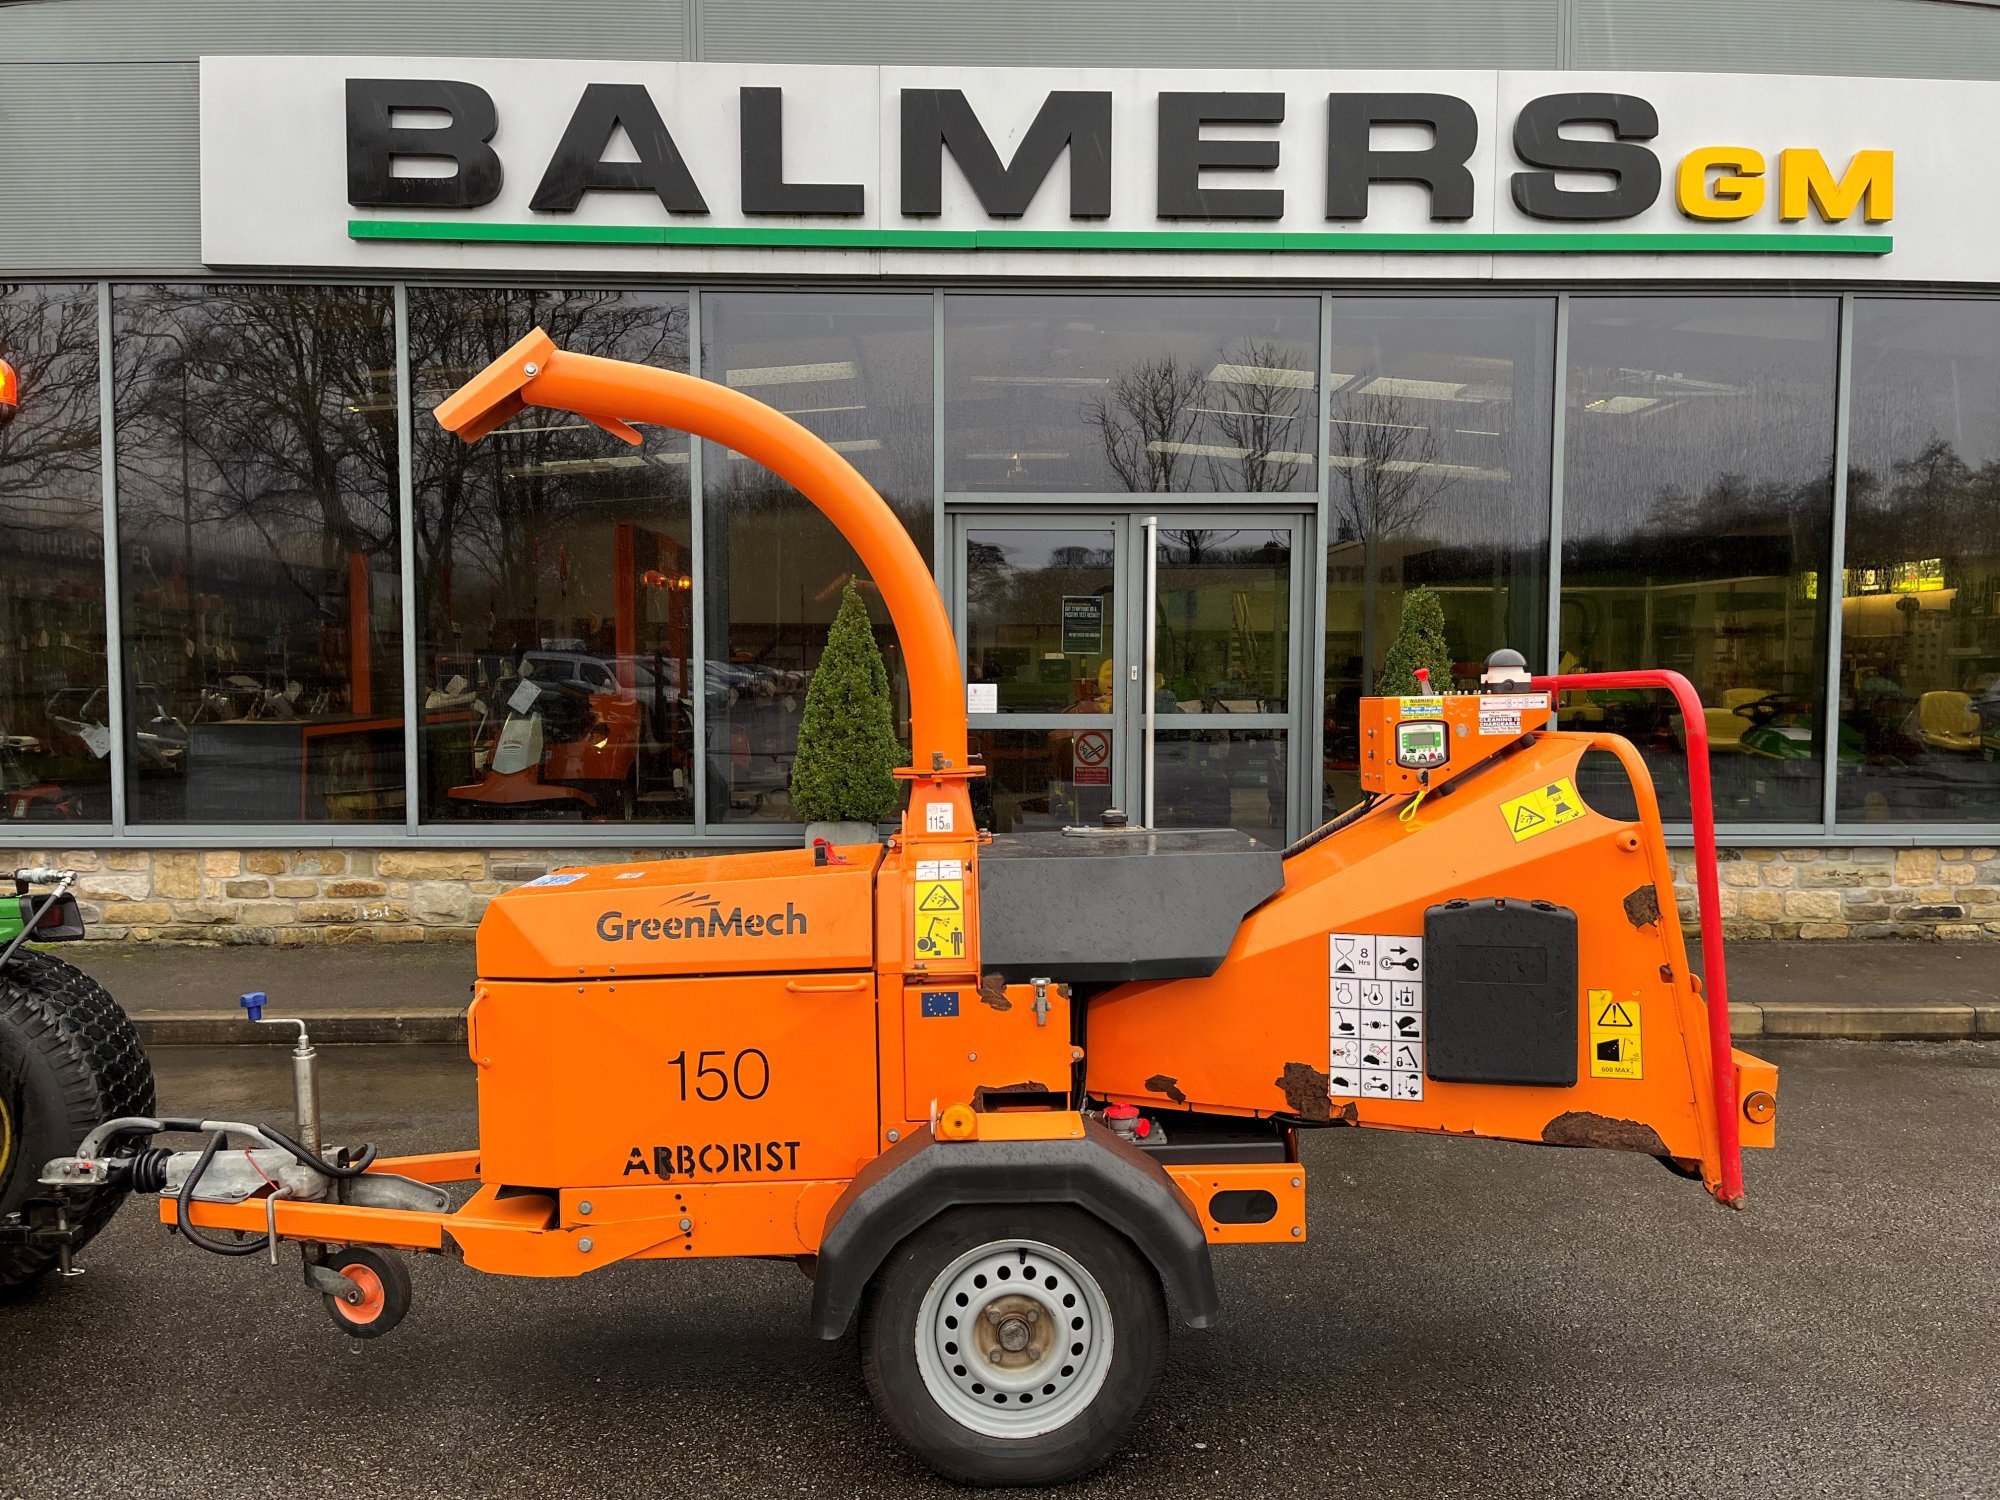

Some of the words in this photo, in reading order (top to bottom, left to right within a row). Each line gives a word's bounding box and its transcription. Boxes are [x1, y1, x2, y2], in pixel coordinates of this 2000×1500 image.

[346, 78, 1661, 221] BALMERS
[1676, 147, 1894, 223] GM
[929, 816, 944, 830] 115
[596, 902, 807, 941] GreenMech
[1360, 948, 1368, 958] 8
[667, 1048, 770, 1101] 150
[623, 1141, 800, 1176] ARBORIST
